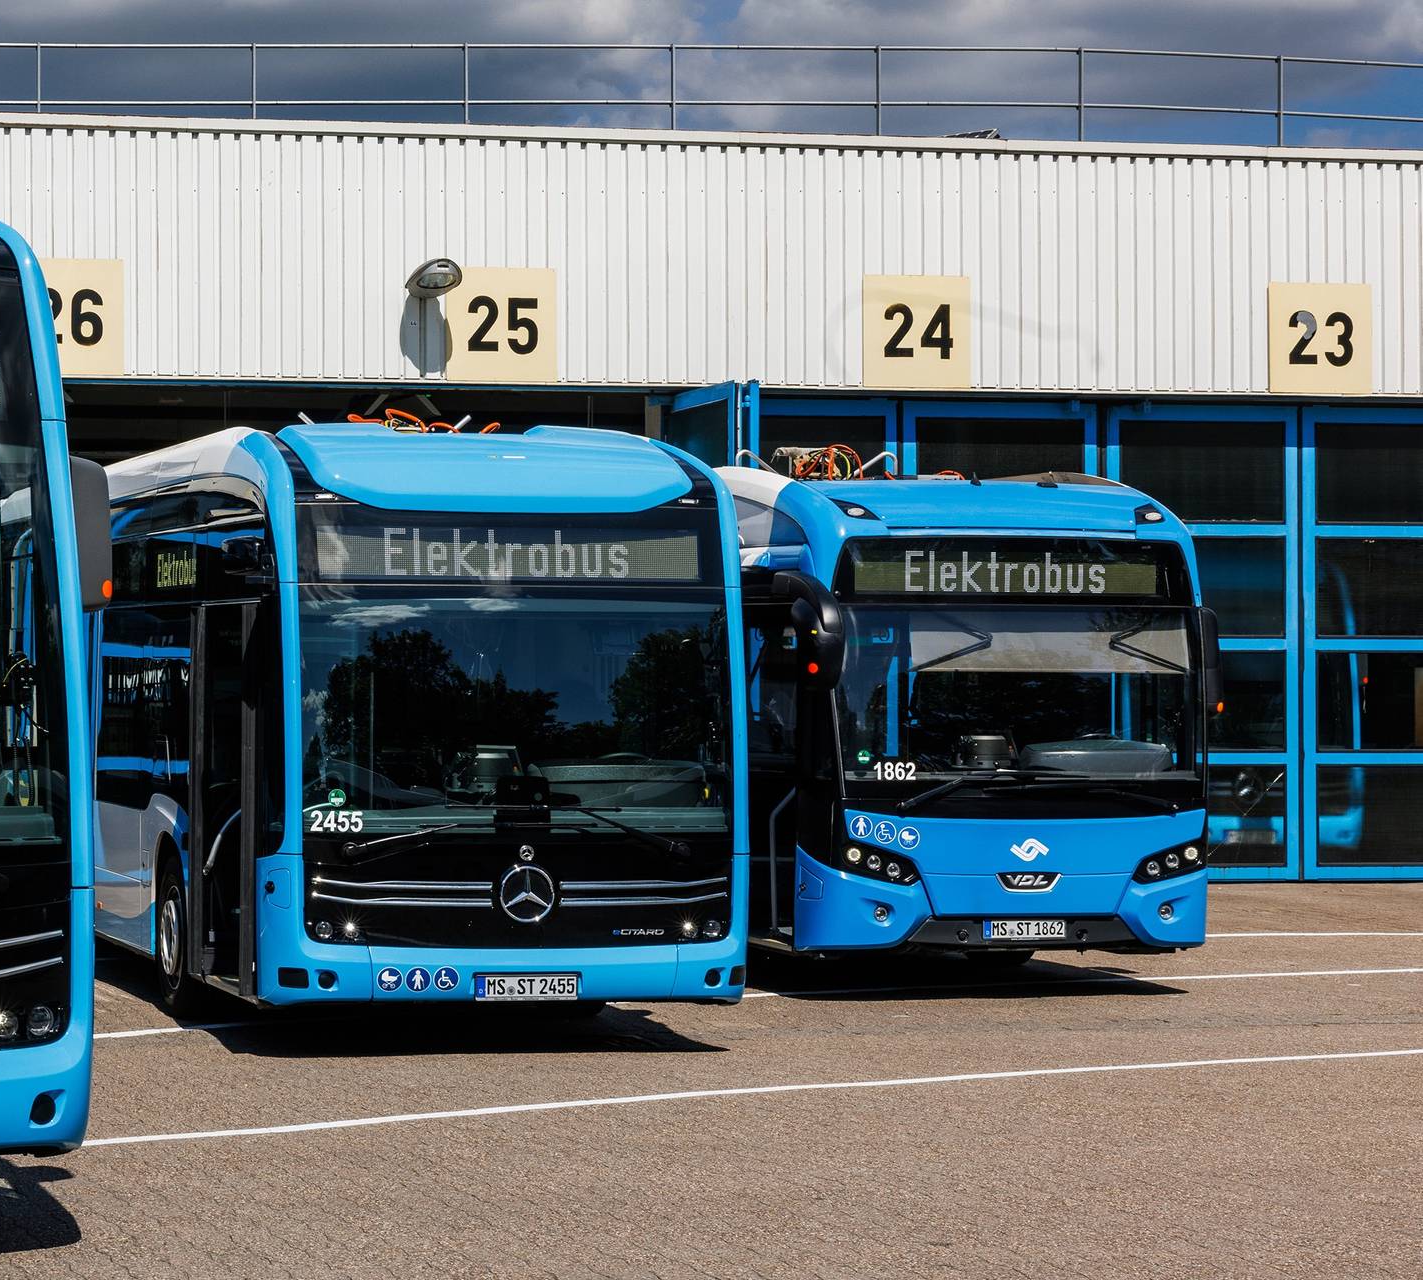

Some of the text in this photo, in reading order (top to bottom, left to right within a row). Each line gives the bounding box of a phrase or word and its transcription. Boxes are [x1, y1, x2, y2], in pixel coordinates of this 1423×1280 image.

[468, 295, 538, 355] 25
[884, 303, 953, 360] 24
[1289, 310, 1354, 367] 23
[384, 528, 629, 578] Elektrobus
[905, 550, 1106, 594] Elektrobus
[873, 761, 917, 781] 1862
[310, 810, 363, 832] 2455
[1006, 874, 1048, 886] VDL
[992, 921, 1064, 936] MS ST 1862
[487, 978, 575, 995] MS ST 2455
